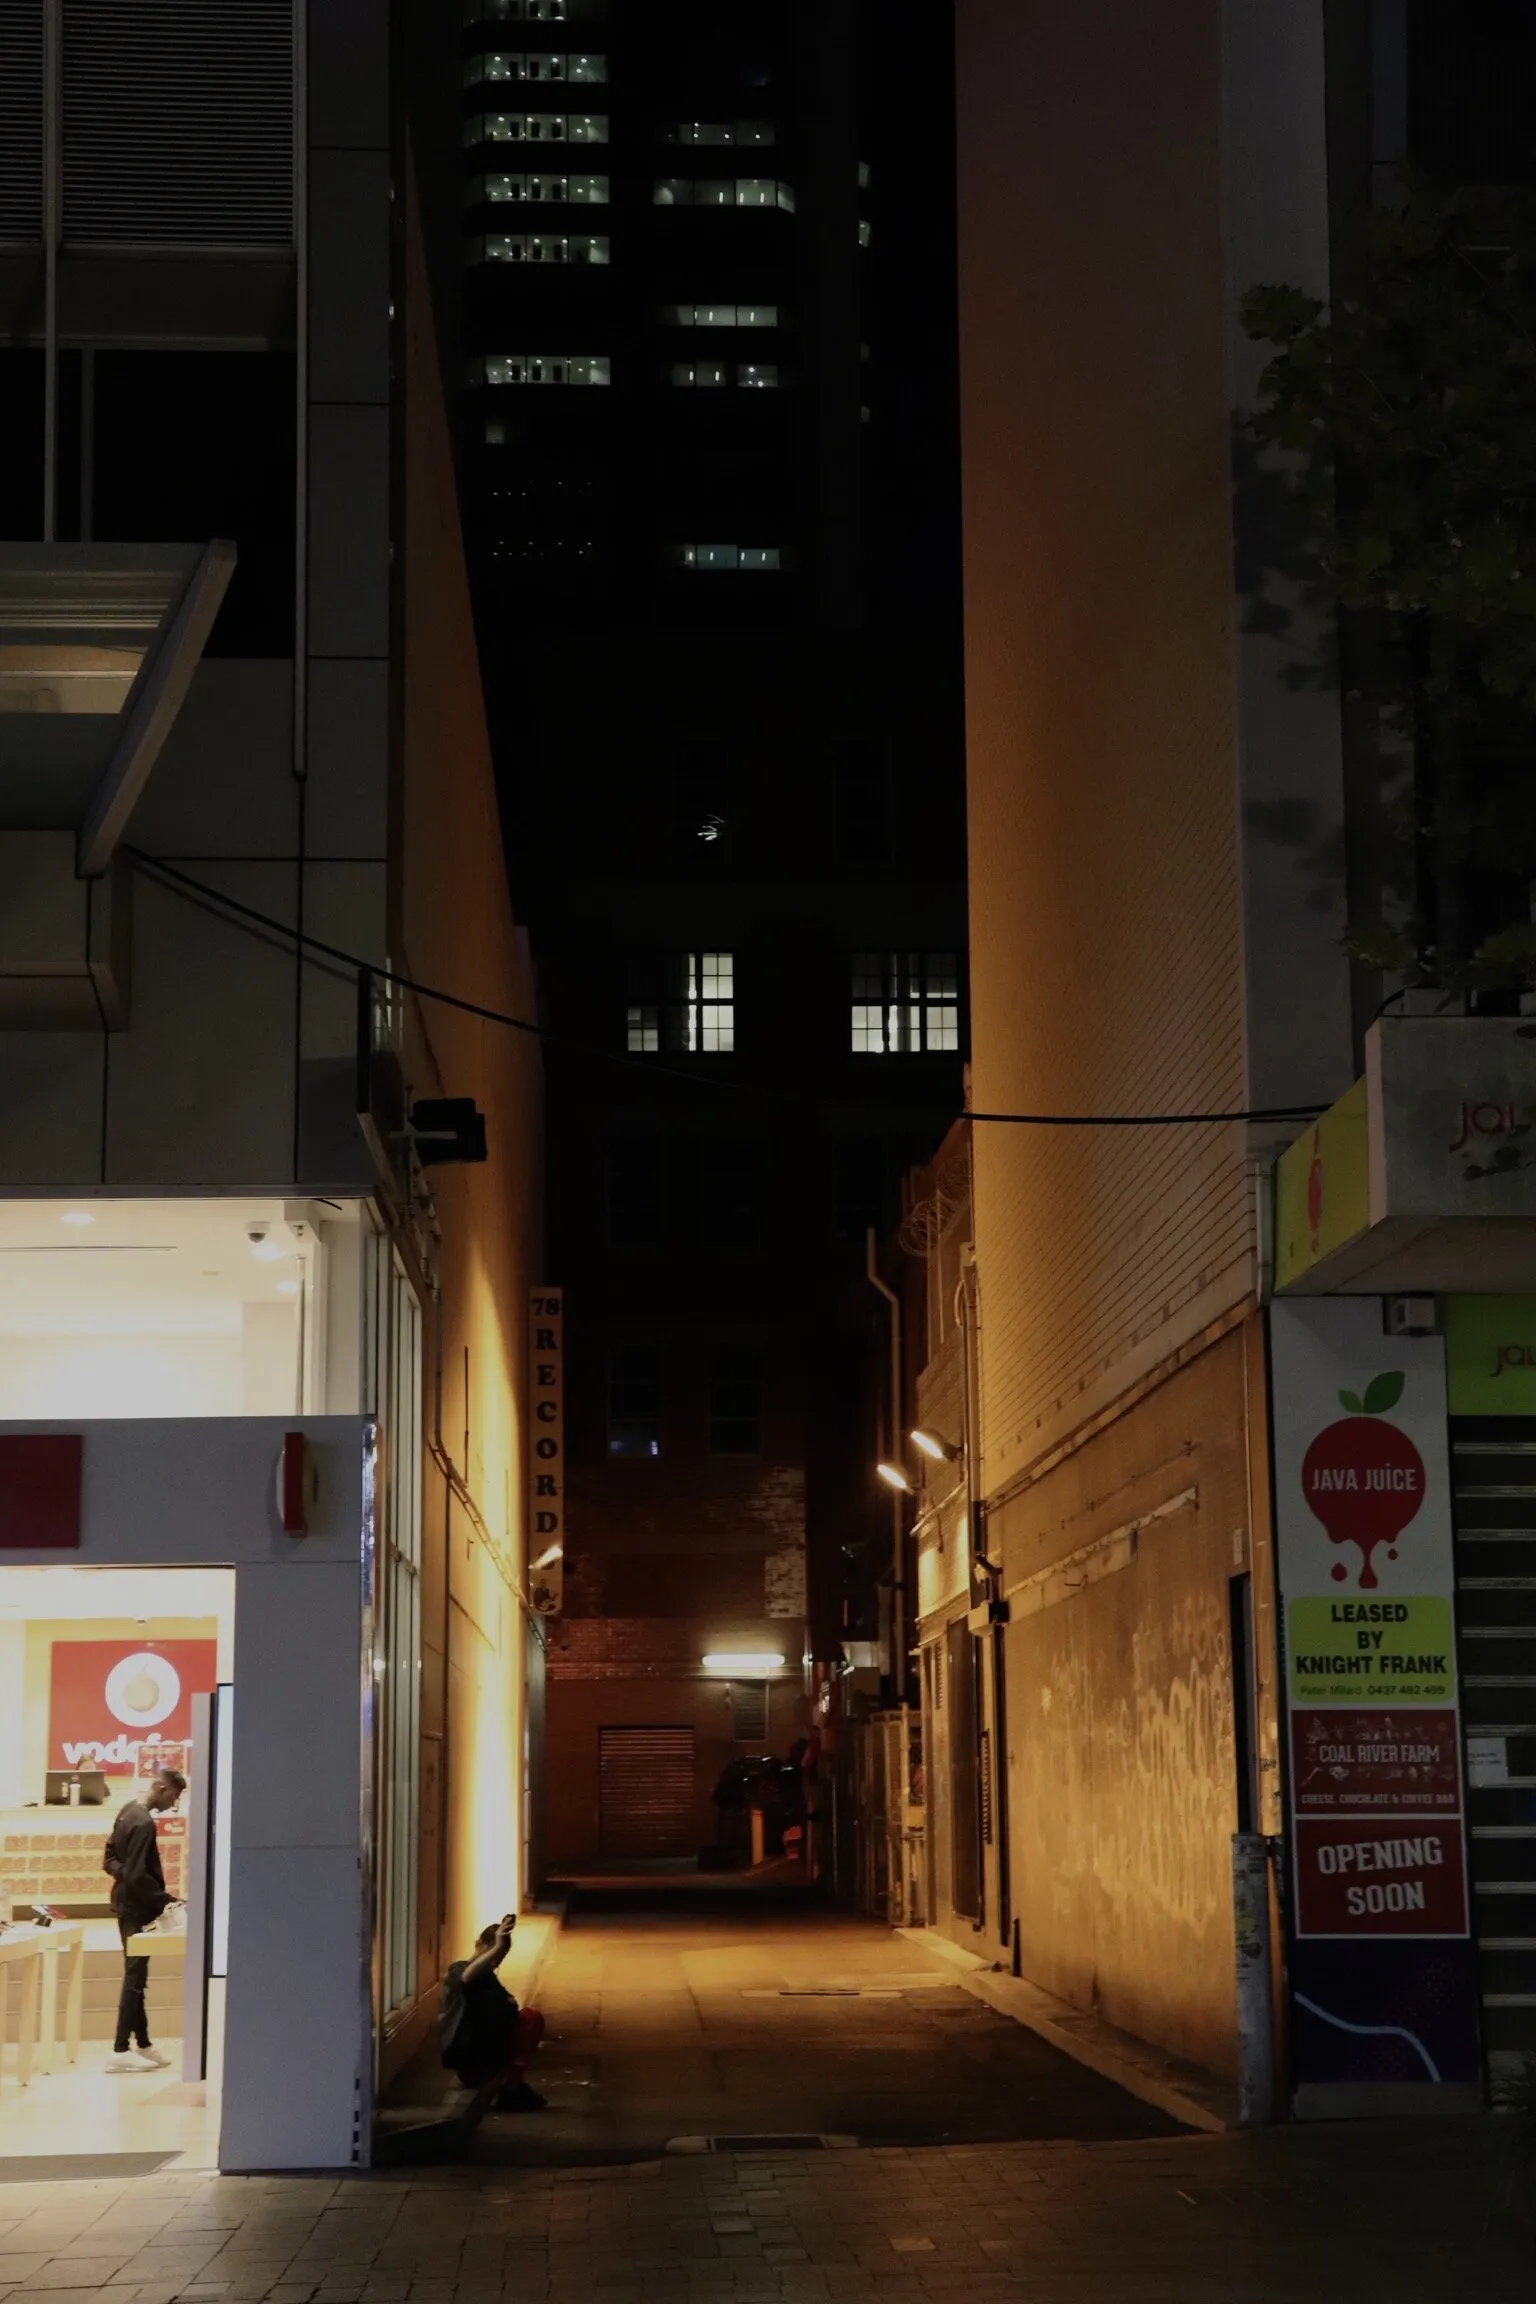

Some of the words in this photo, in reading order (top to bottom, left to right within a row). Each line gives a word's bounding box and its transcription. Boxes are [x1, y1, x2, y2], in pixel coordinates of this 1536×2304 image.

[532, 1299, 559, 1315] 78
[1312, 1469, 1358, 1490] JAVA
[1332, 1604, 1408, 1622] LEASED
[1358, 1631, 1383, 1649] BY
[1296, 1656, 1373, 1674] KNIGHT
[1380, 1656, 1446, 1674] FRANK
[1319, 1745, 1355, 1763] COAL
[1358, 1745, 1398, 1763] RIVER
[1401, 1745, 1440, 1763] FARM
[1317, 1836, 1444, 1875] OPENING
[1346, 1881, 1426, 1916] SOON
